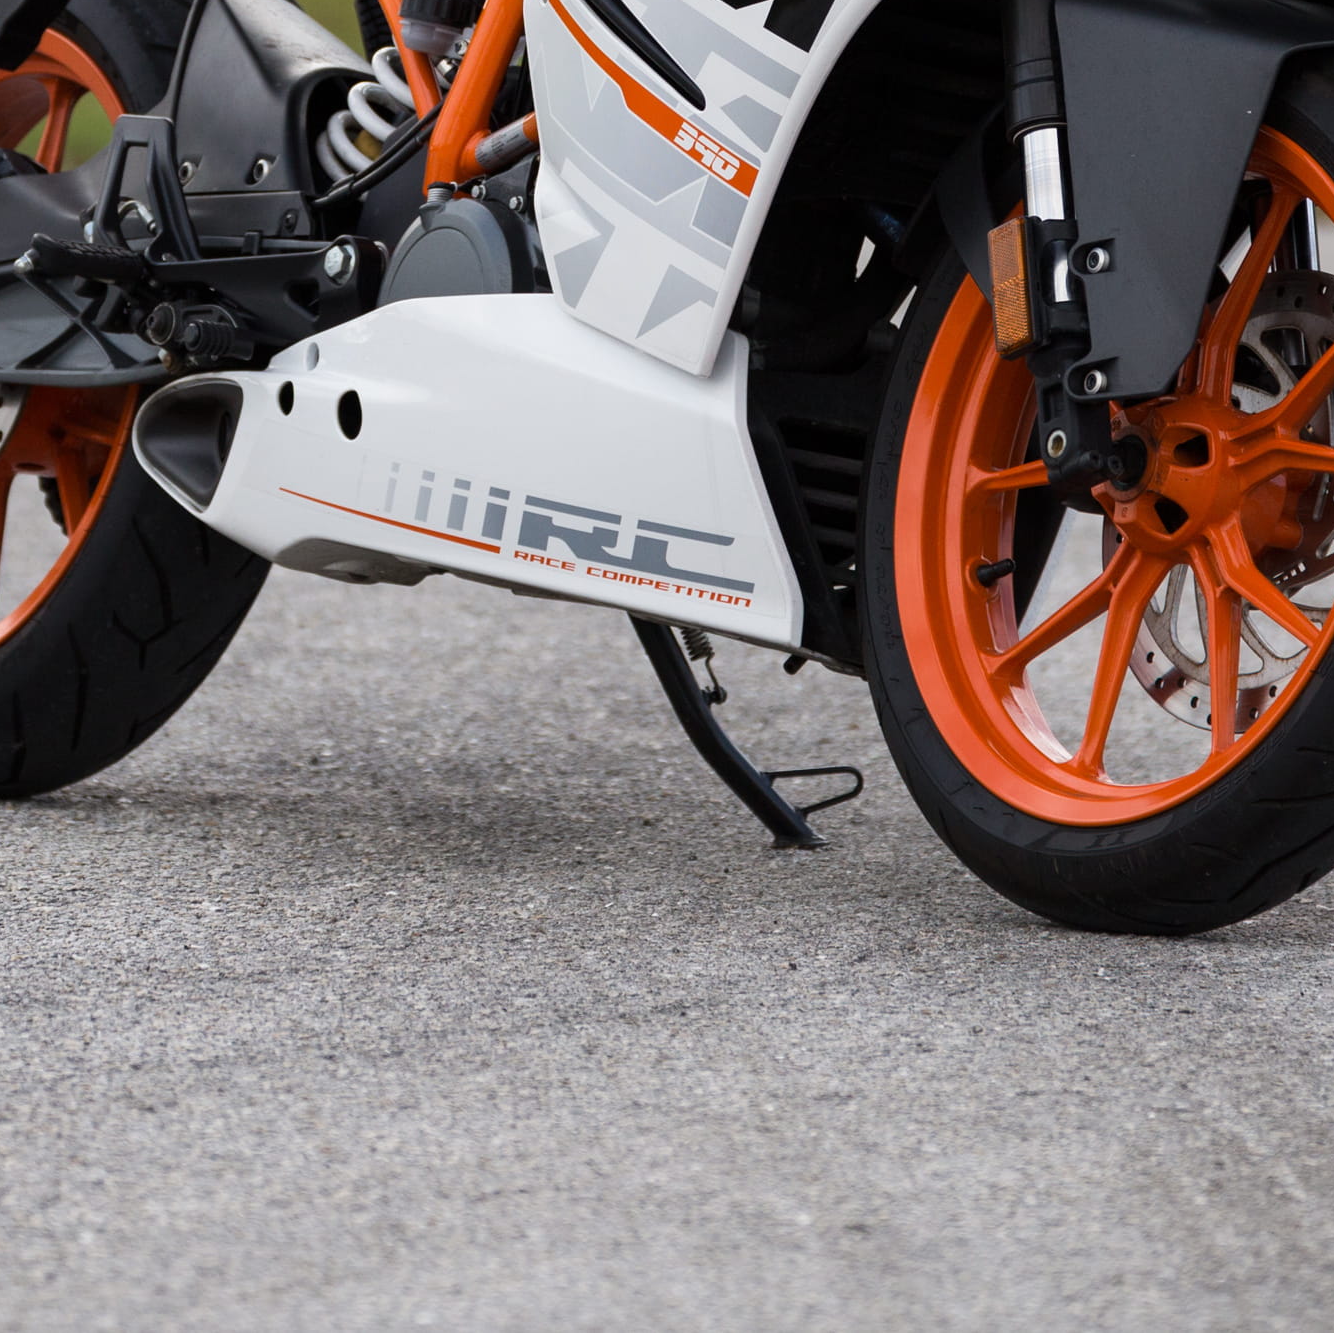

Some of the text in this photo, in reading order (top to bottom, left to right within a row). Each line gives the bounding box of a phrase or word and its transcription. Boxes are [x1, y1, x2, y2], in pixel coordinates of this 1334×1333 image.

[673, 121, 741, 181] 390
[518, 495, 755, 593] RC
[514, 550, 752, 608] RACE COMPETITION
